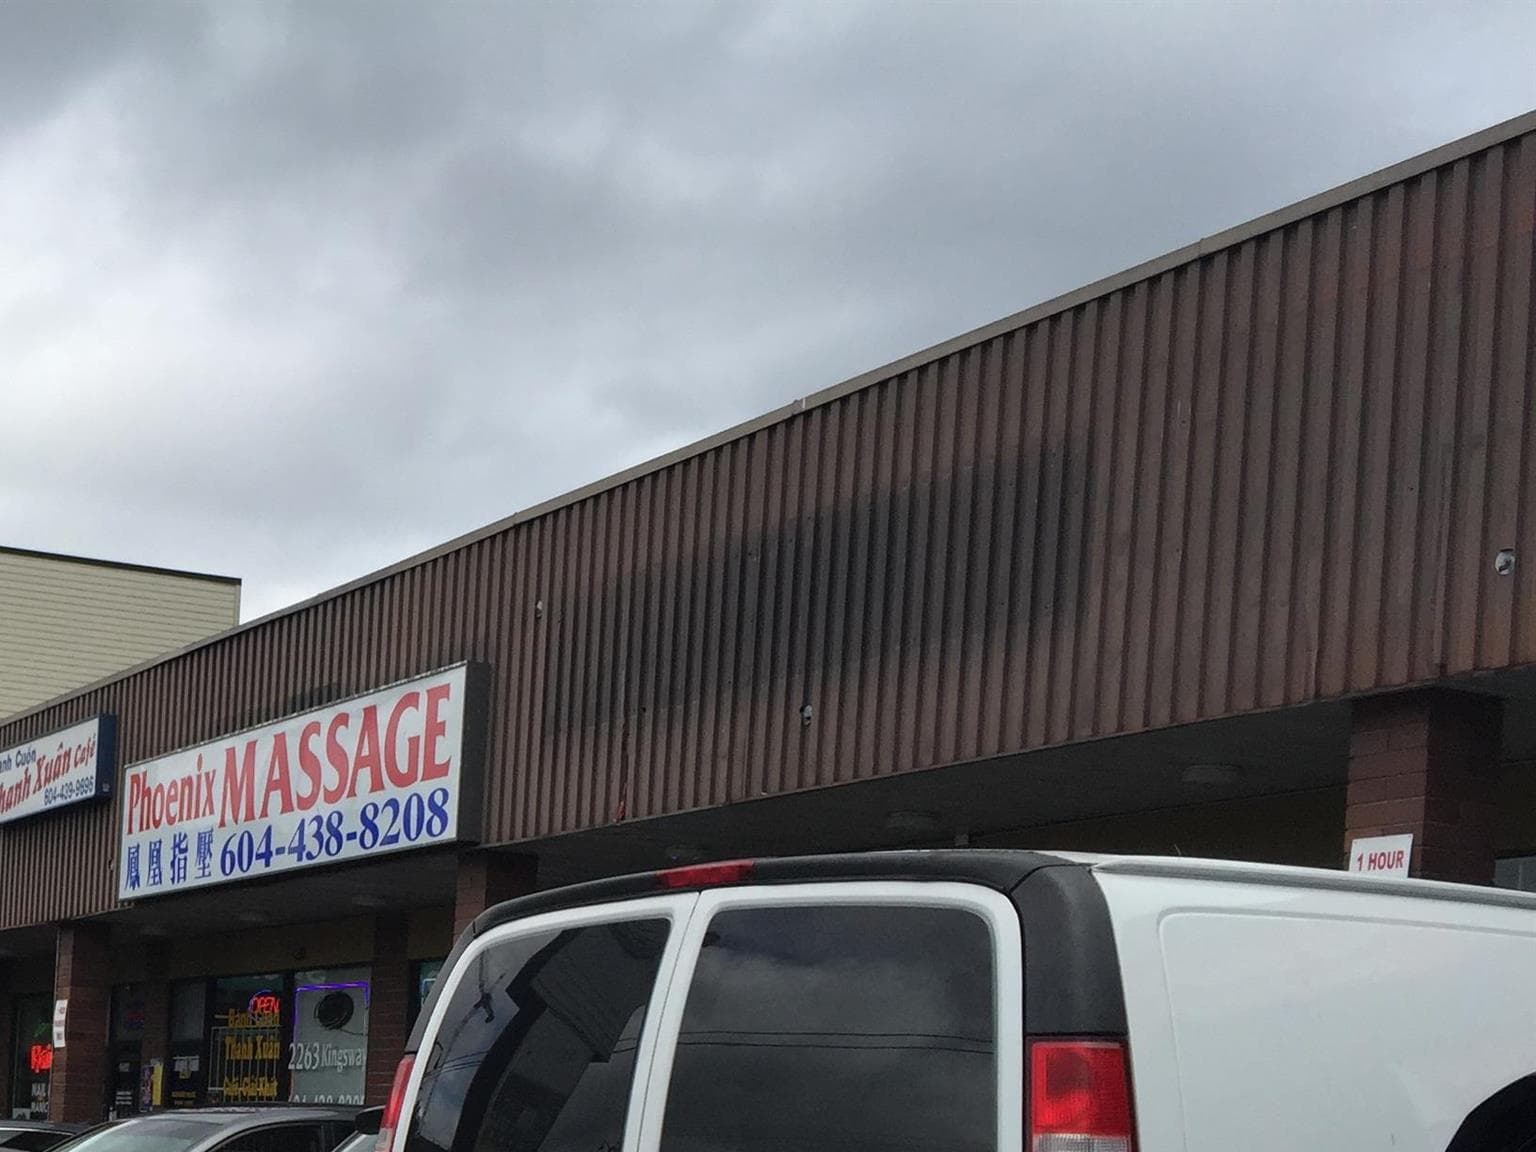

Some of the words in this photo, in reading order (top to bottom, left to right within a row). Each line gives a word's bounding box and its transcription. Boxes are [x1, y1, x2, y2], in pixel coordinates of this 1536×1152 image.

[126, 752, 216, 836] Phoenix
[218, 683, 452, 829] MASSAGE
[220, 787, 450, 877] 604-438-8208
[1357, 853, 1364, 871] 1
[1368, 850, 1404, 870] HOUR
[288, 1043, 319, 1070] 2263
